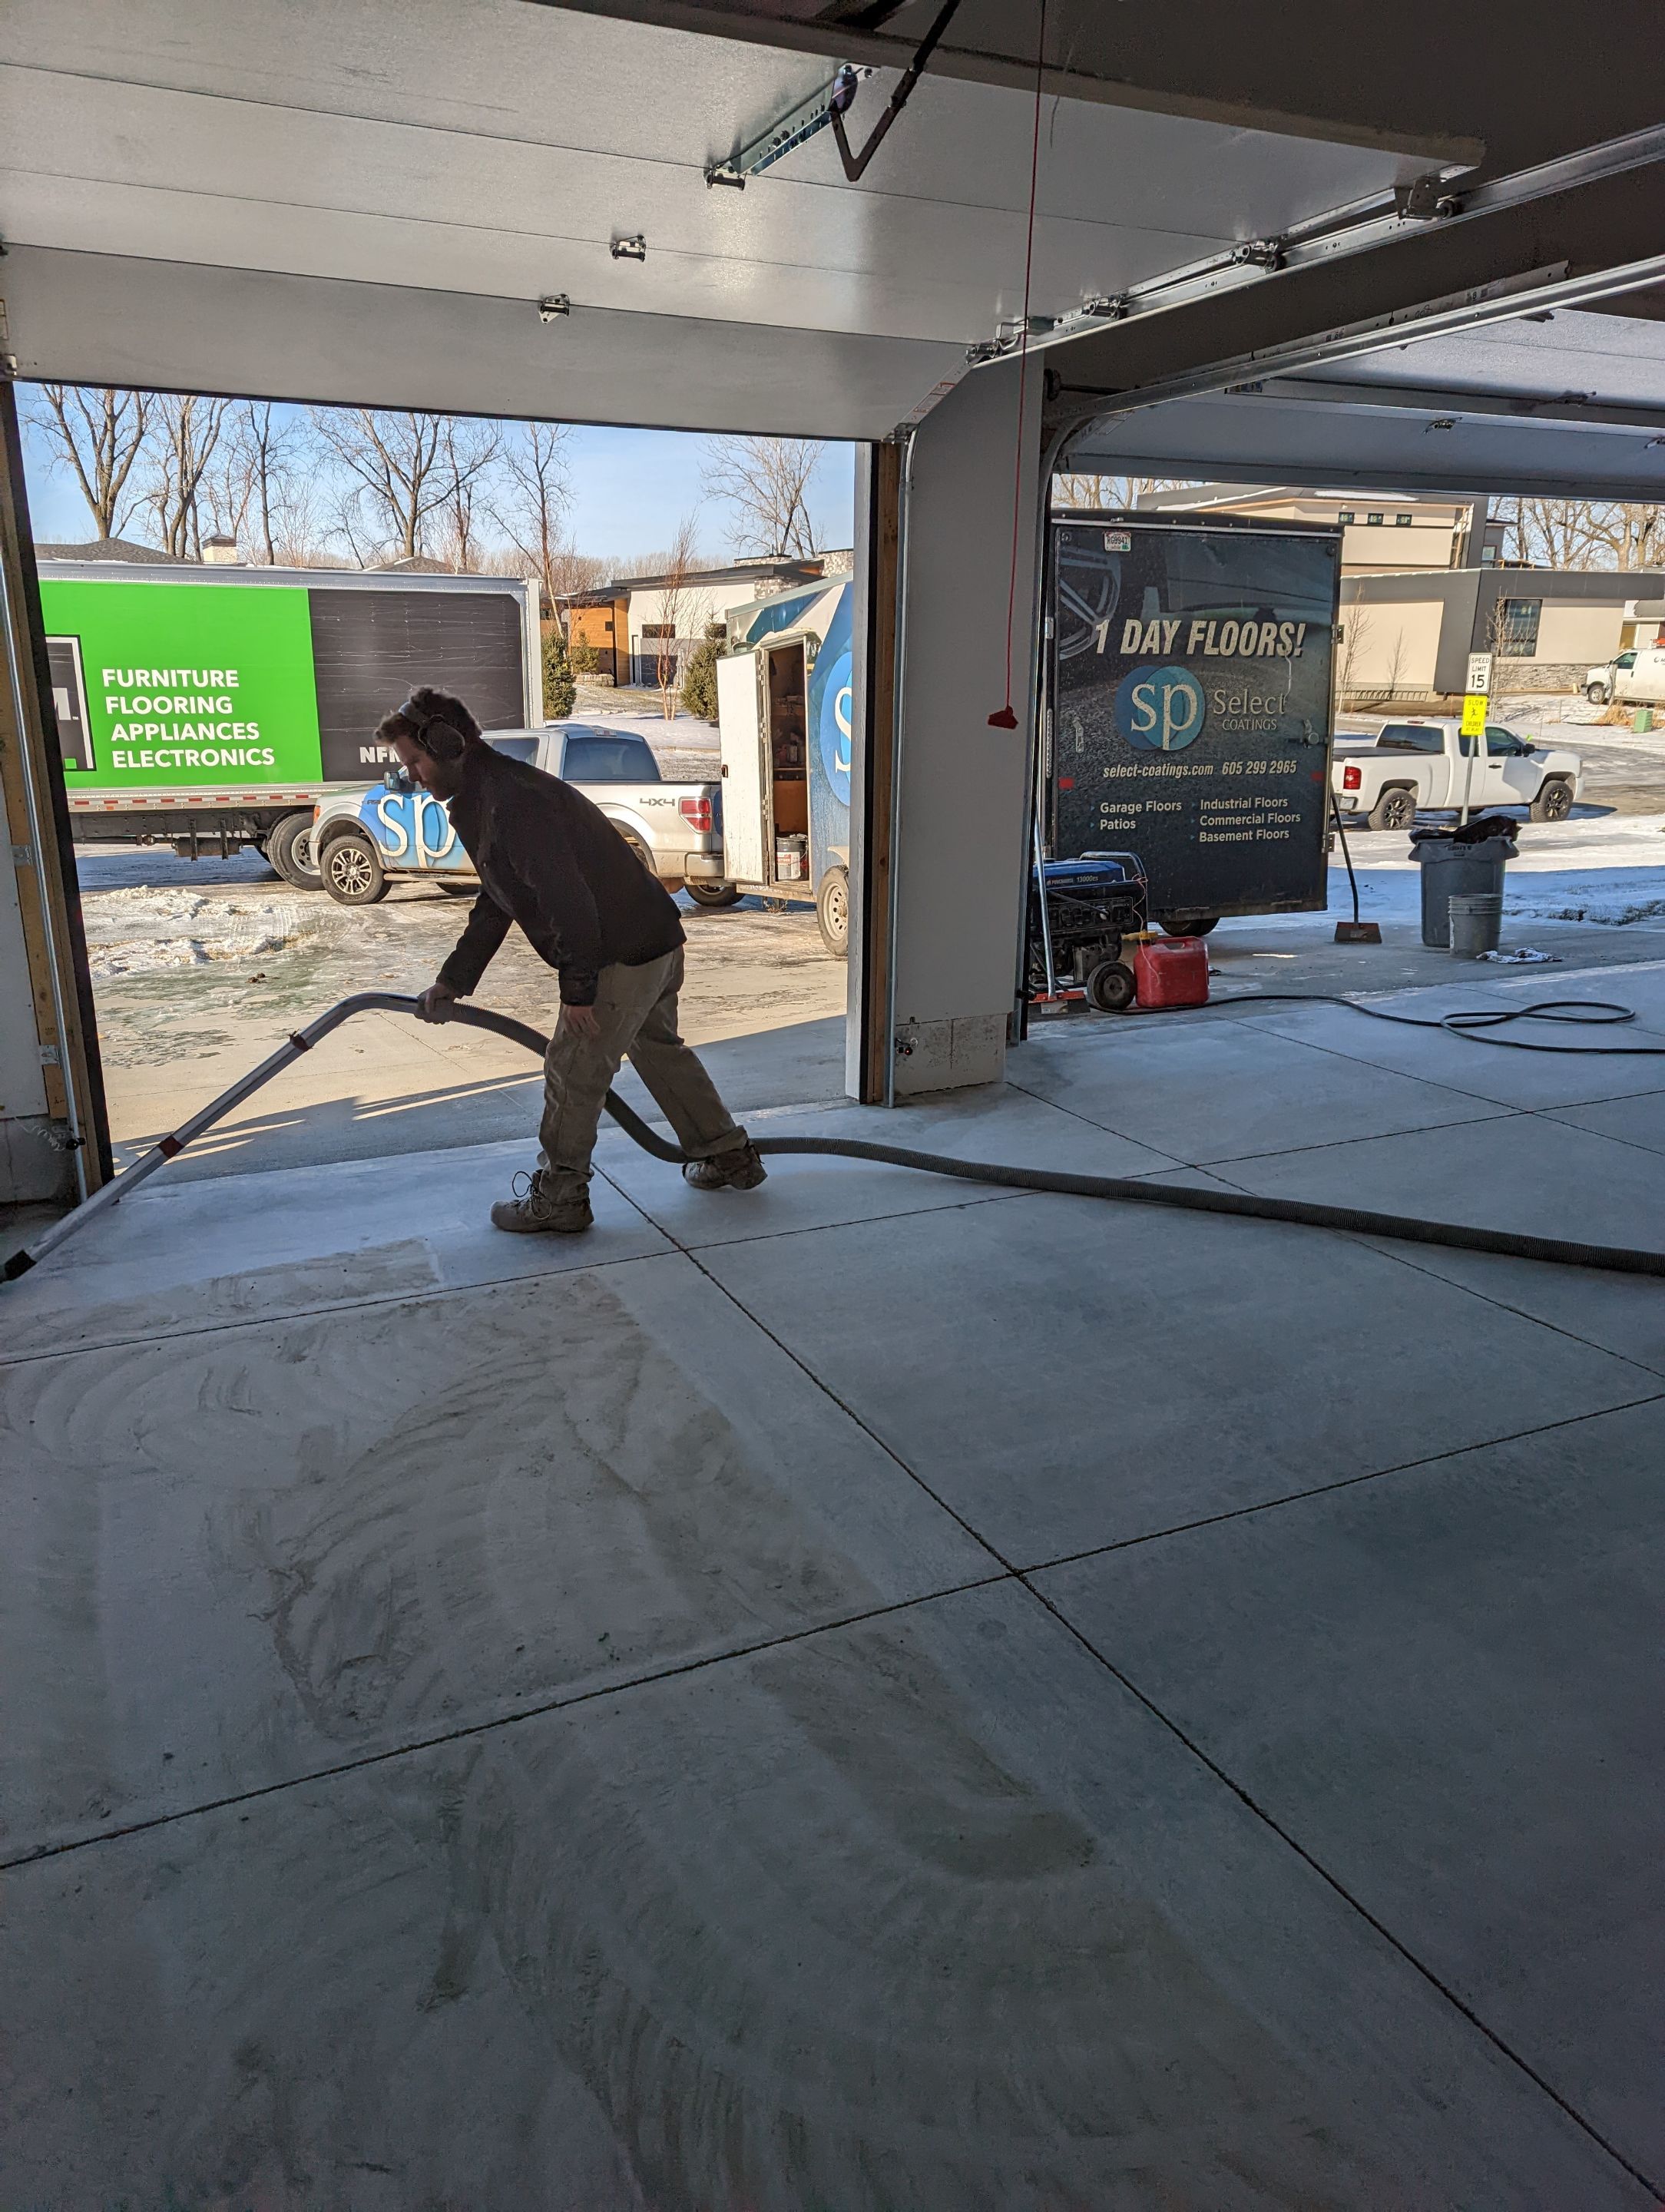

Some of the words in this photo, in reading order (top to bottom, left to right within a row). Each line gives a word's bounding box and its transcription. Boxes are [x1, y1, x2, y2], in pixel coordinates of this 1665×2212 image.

[1095, 619, 1109, 654] 1
[1120, 619, 1181, 654] DAY
[1187, 620, 1306, 657] FLOORS!
[102, 668, 240, 688] FURNITURE
[1471, 674, 1485, 688] 15
[105, 696, 233, 715] FLOORING
[1213, 689, 1286, 715] Select
[1130, 683, 1197, 751] sp
[1222, 718, 1278, 731] COATINGS
[111, 722, 260, 742] APPLIANCES
[112, 747, 275, 769] ELECTRONICS
[1103, 763, 1214, 779] select-coatings.com
[1222, 761, 1243, 775] 605
[1246, 761, 1266, 775] 299
[1269, 760, 1297, 774] 2965
[1100, 803, 1143, 815] Garage
[1146, 800, 1182, 812] Floors
[1200, 798, 1252, 810] Industrial
[1254, 797, 1289, 807] Floors
[1100, 819, 1137, 830] Patios
[1200, 814, 1265, 826] Commercial
[1268, 813, 1301, 824] Floors
[377, 793, 456, 869] sp
[1199, 830, 1253, 842] Basement
[1256, 830, 1290, 840] Floors
